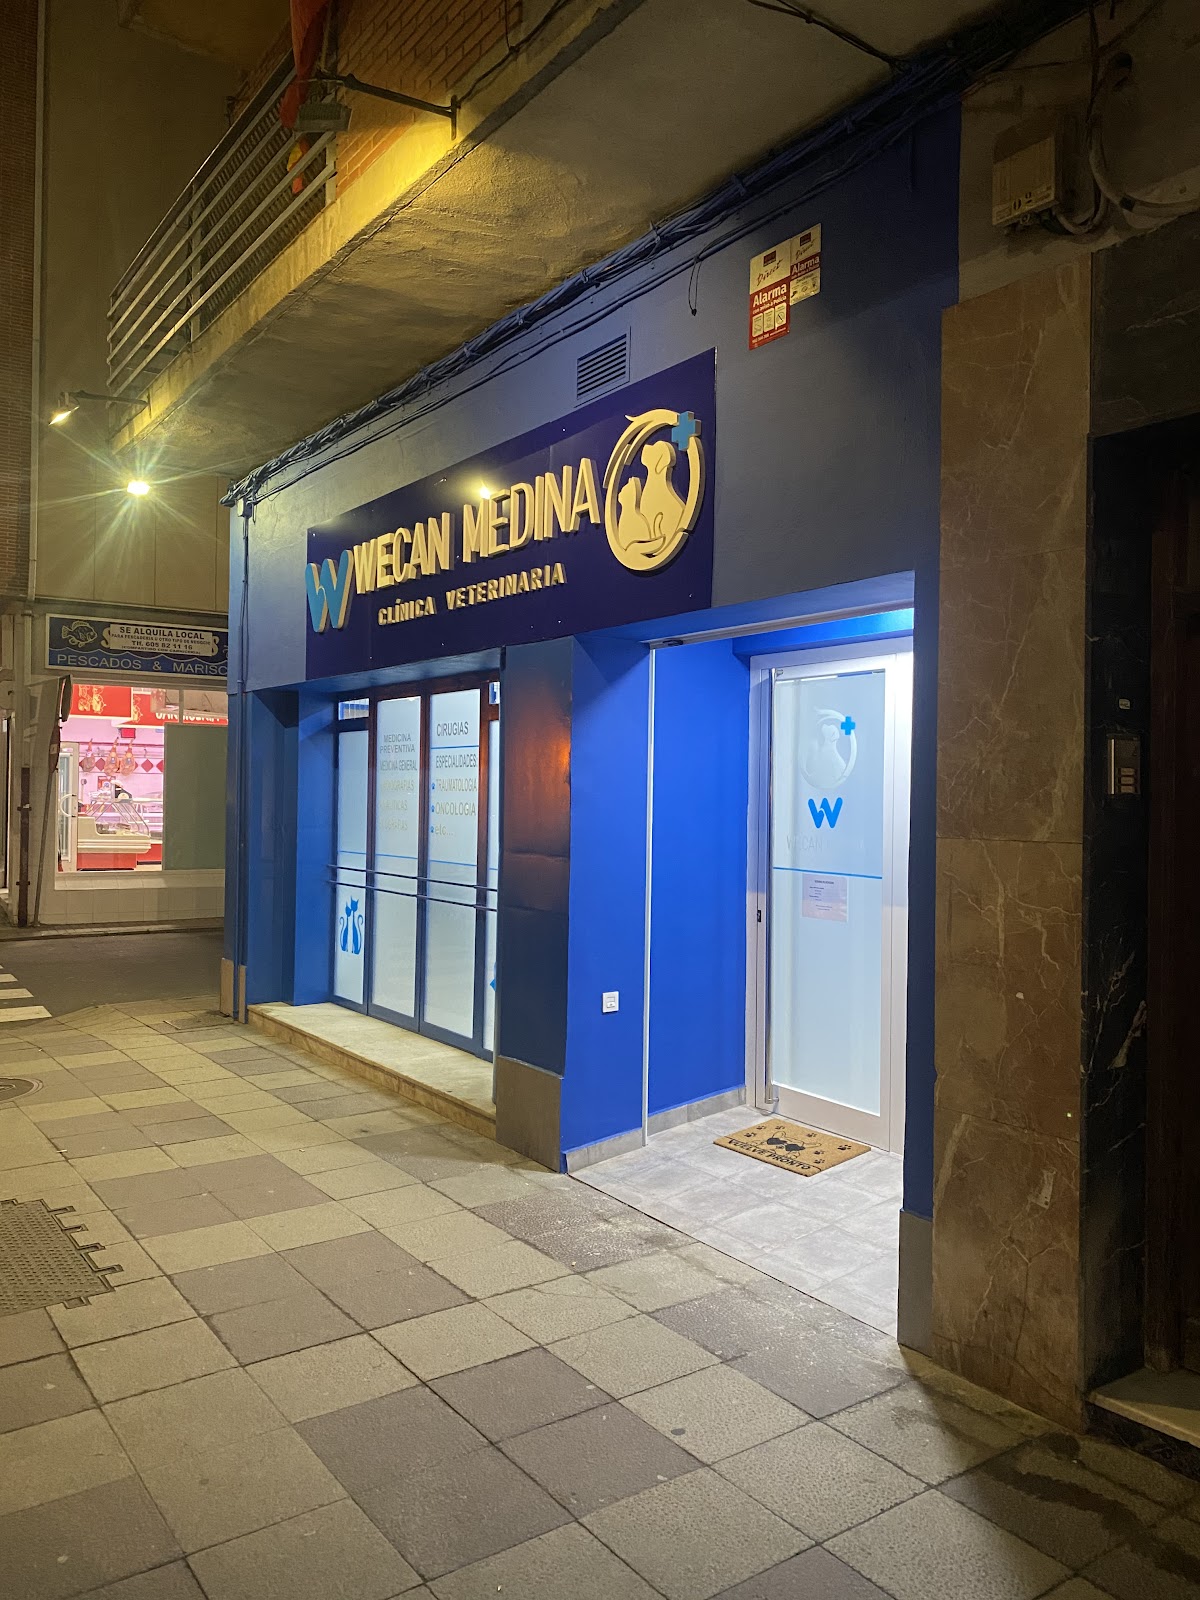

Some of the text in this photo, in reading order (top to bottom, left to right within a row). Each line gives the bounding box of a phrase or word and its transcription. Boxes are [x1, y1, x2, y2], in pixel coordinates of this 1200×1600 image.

[792, 256, 820, 275] Alarma
[753, 283, 787, 307] Alarma
[353, 512, 454, 595] WECAN
[462, 457, 601, 563] MEDINA
[378, 562, 567, 626] CLÍNICA VETERINARIA
[119, 626, 205, 640] SE ALQUILA LOCAL
[58, 654, 142, 670] PESCADOS
[152, 661, 162, 671] &
[436, 721, 469, 737] CIRUGIAS
[383, 733, 412, 743] MEDICINA
[380, 744, 416, 754] PREVENTIVA
[435, 802, 476, 816] ONCOLOGIA
[765, 1150, 811, 1170] PRONTO
